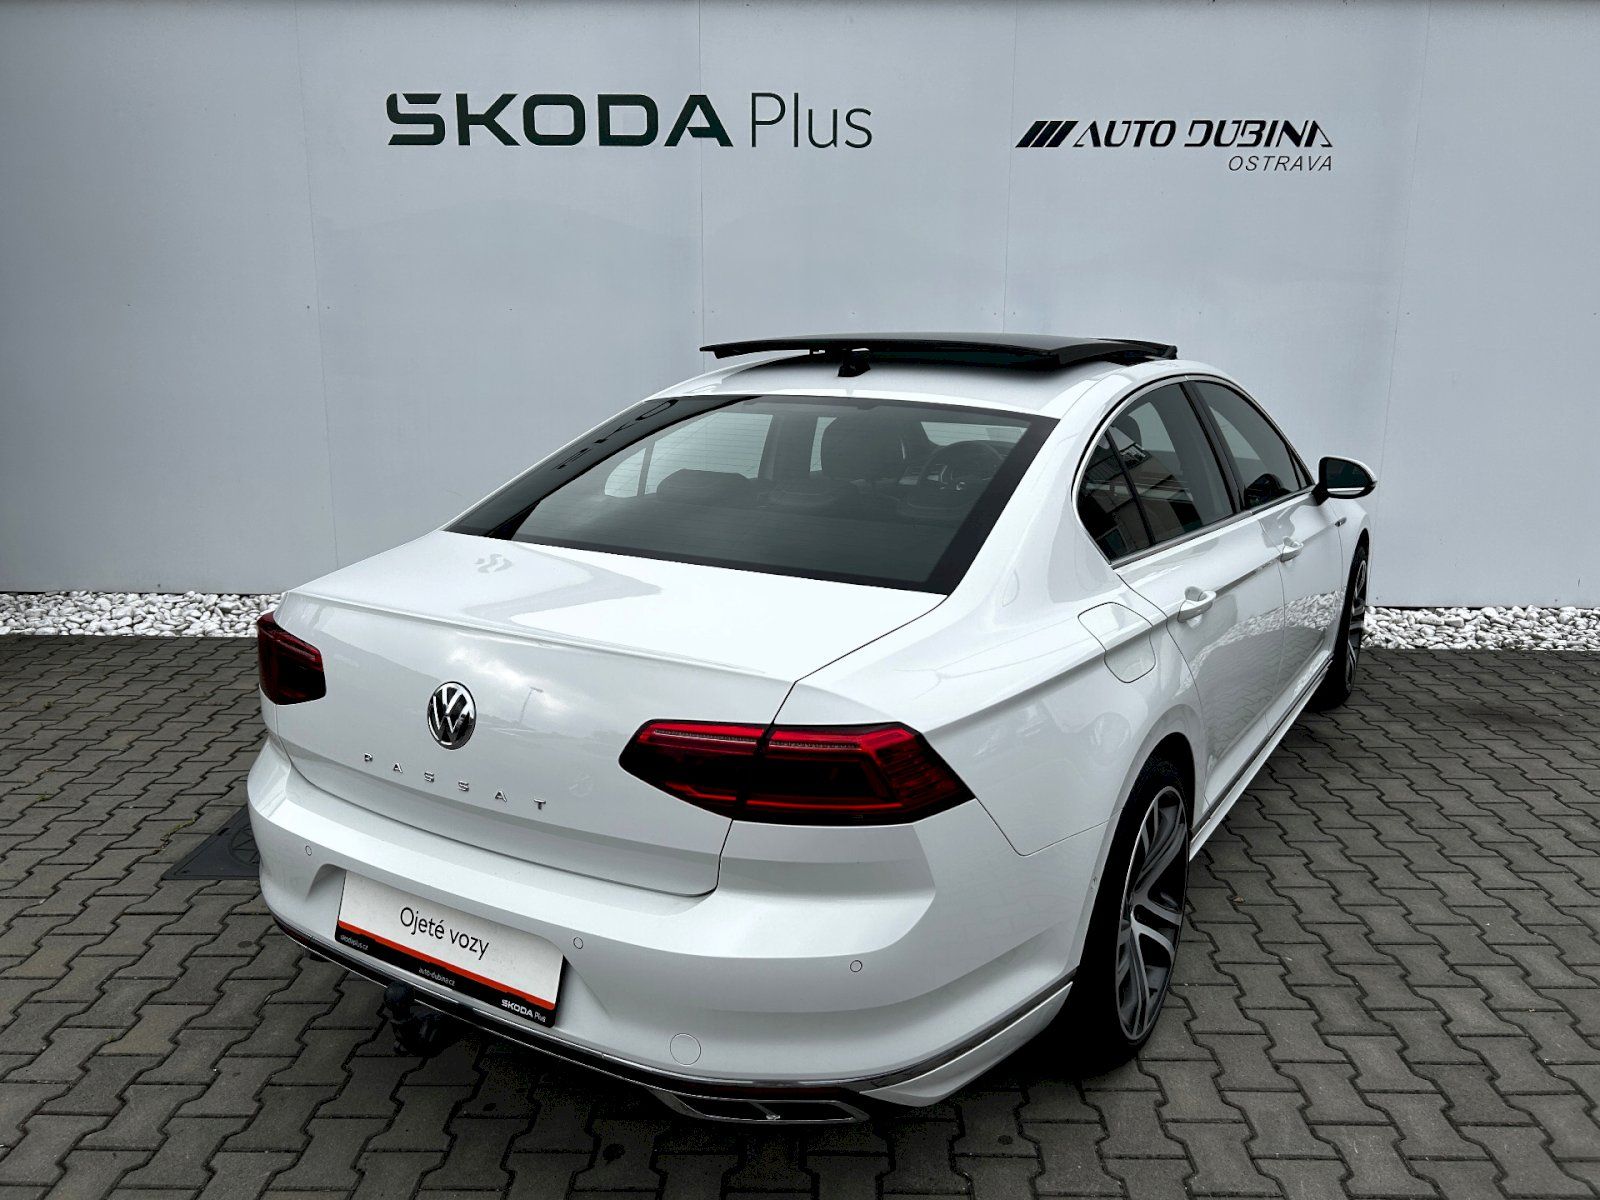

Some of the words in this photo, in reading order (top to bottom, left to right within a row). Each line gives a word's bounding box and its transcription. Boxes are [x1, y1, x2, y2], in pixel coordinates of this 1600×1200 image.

[750, 92, 873, 149] Plus
[1072, 119, 1177, 148] AUTO
[1183, 119, 1333, 148] DUBINA
[1228, 155, 1333, 172] OSTRAVA
[427, 681, 477, 750] VW
[364, 752, 547, 810] PASSAT
[400, 907, 445, 940] Ojeté
[449, 928, 490, 961] vozy
